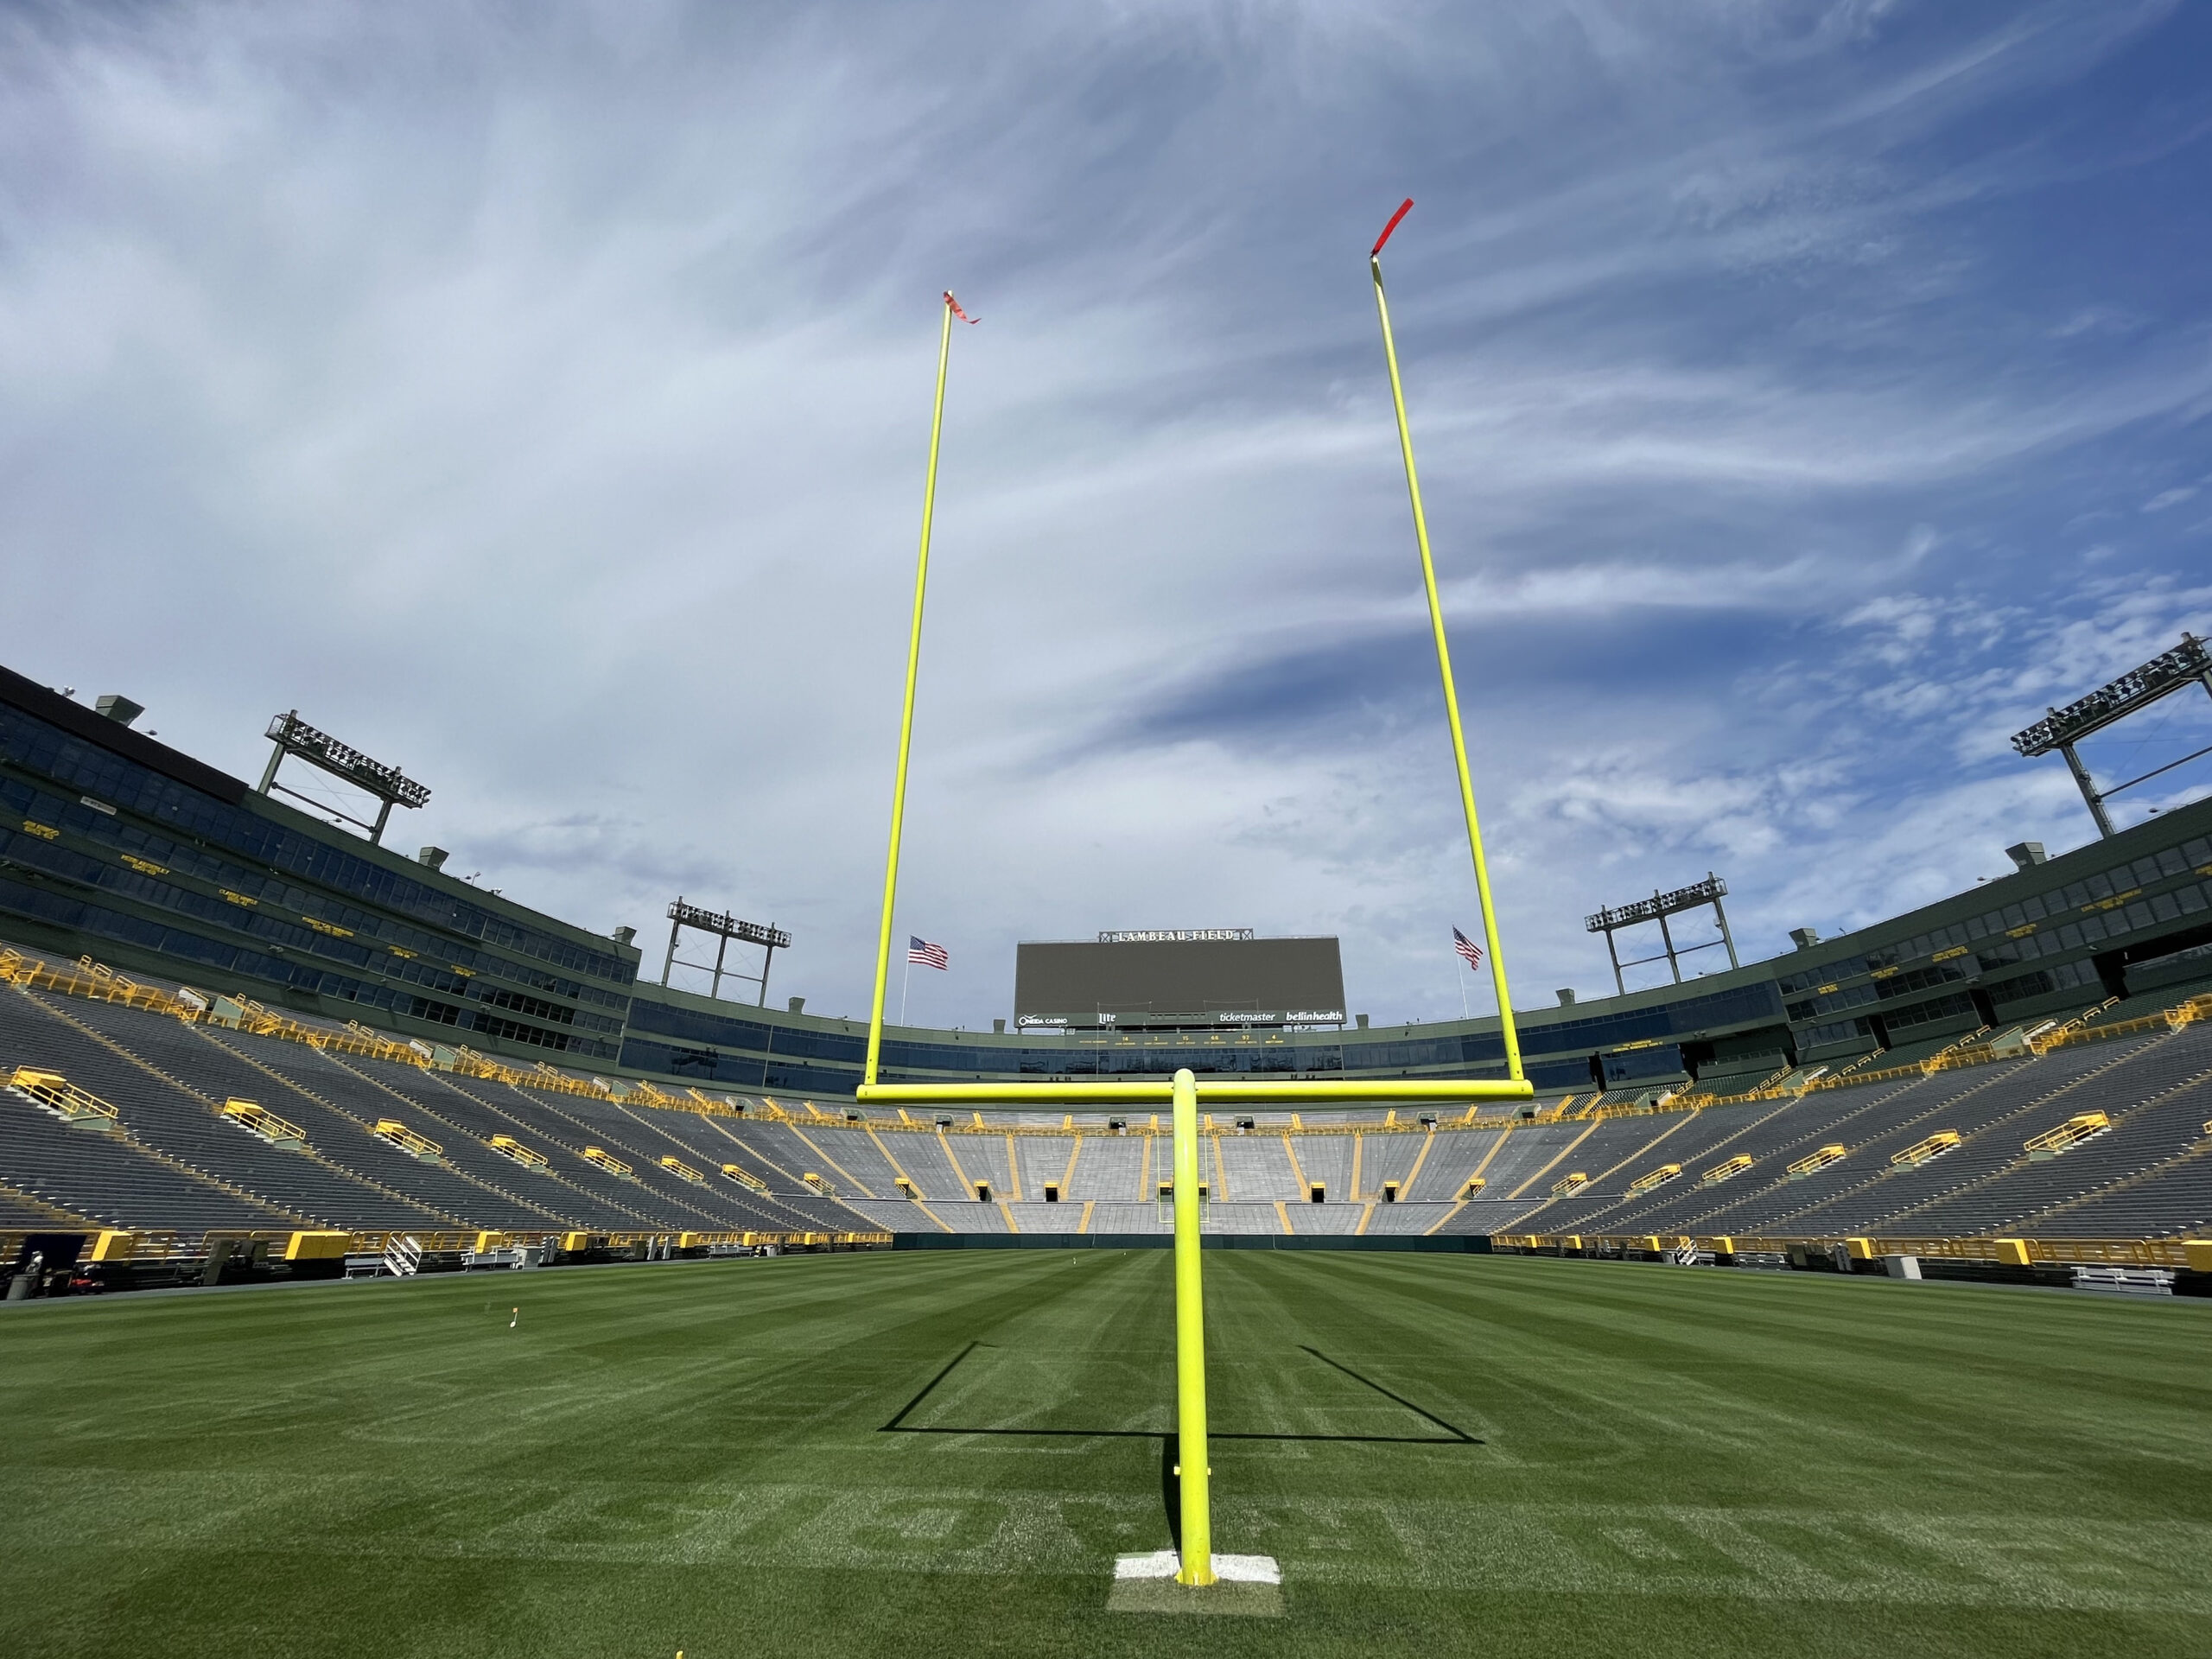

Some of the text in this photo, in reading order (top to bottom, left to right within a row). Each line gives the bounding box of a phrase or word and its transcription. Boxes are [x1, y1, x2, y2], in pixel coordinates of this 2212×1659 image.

[1119, 930, 1234, 942] LAMBEAU FIELD
[1098, 1013, 1116, 1025] Lite
[1219, 1013, 1276, 1021] ticketmaster
